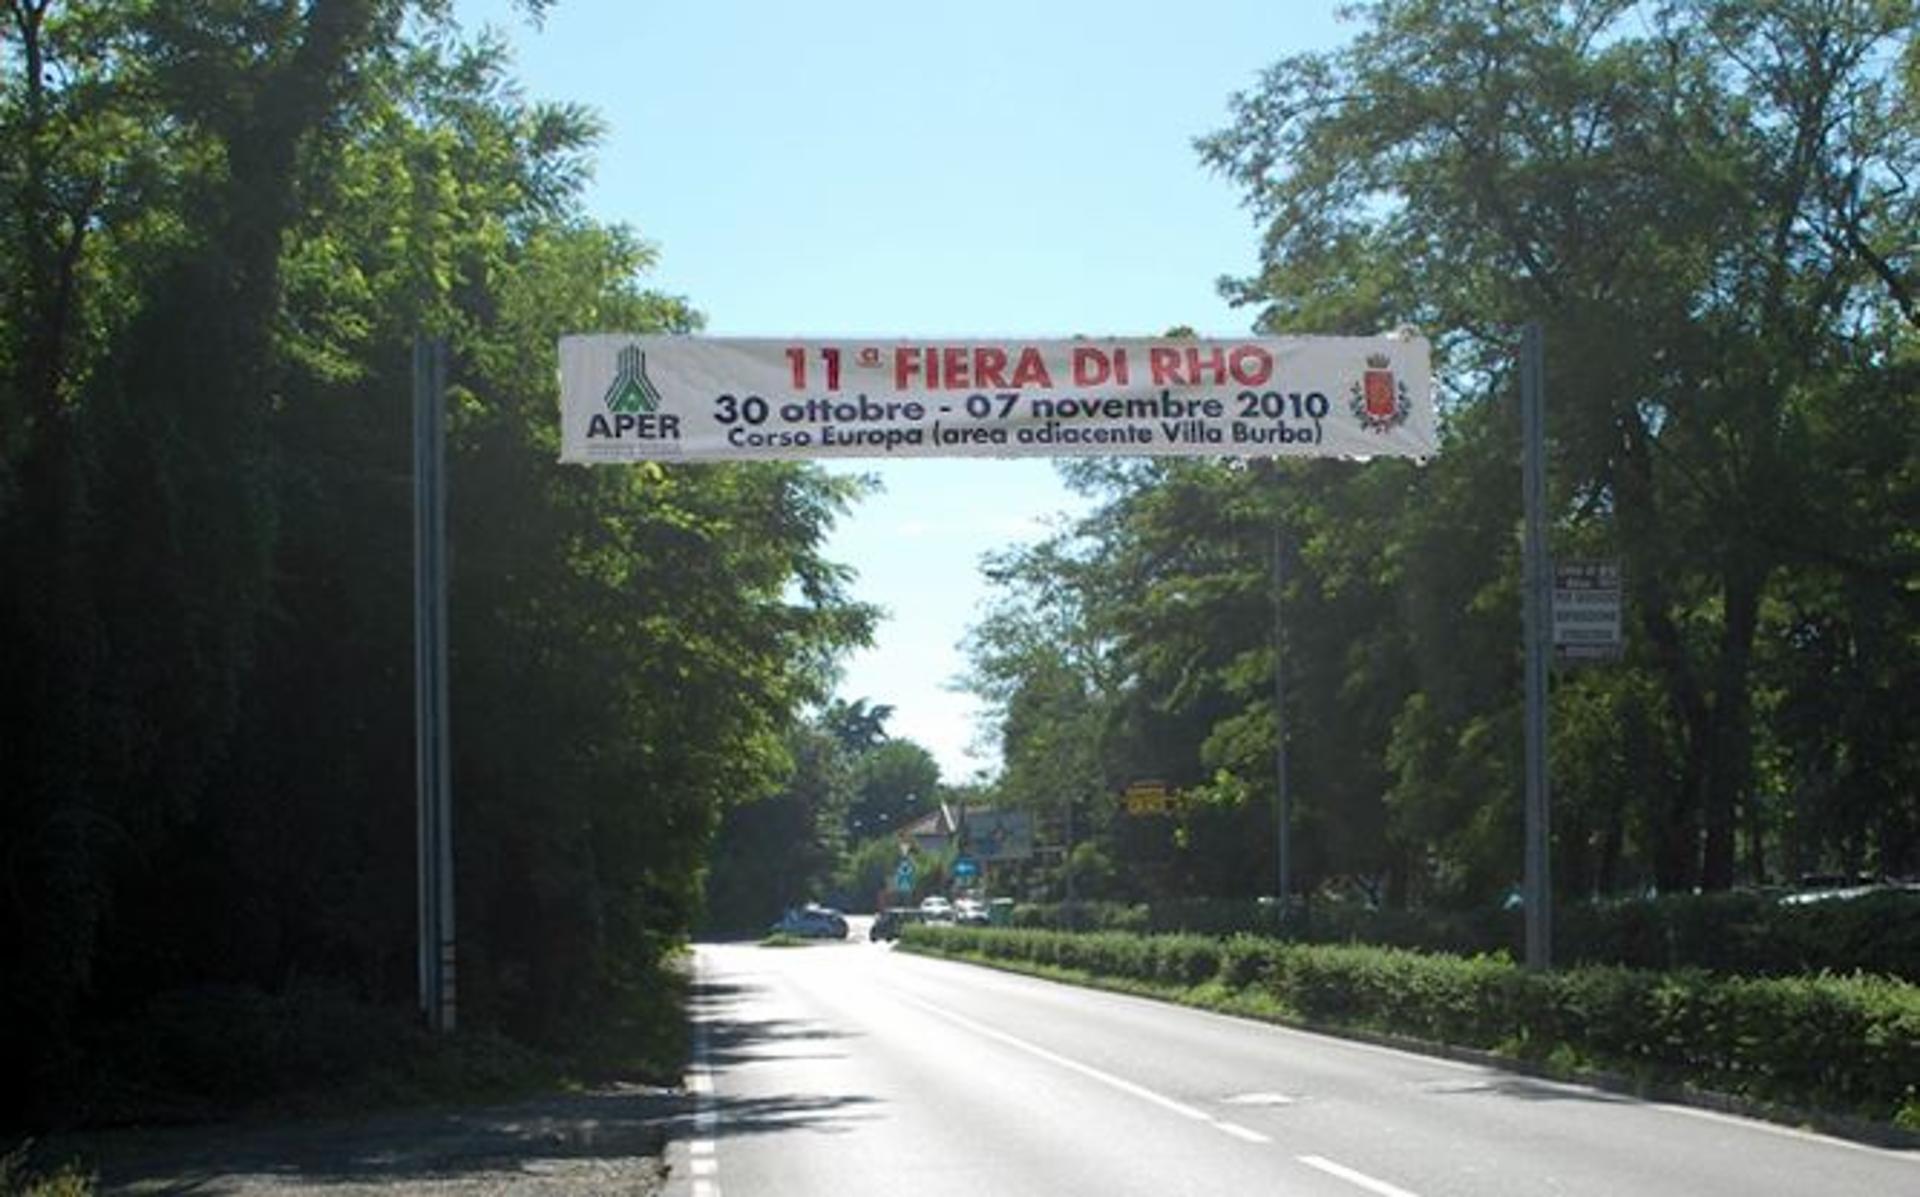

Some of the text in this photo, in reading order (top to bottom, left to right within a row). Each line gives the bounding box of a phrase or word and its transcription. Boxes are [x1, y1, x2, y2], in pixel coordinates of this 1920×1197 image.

[894, 347, 1052, 390] FIERA
[1073, 346, 1129, 387] DI
[1151, 345, 1275, 387] RHO
[713, 394, 768, 425] 30
[780, 394, 924, 424] ottobre
[966, 393, 1020, 420] 07
[1031, 391, 1223, 419] novembre
[1236, 391, 1329, 418] 2010
[587, 413, 681, 440] APER
[728, 418, 1324, 450] Corso Europa (area adiacente Villa Burba)
